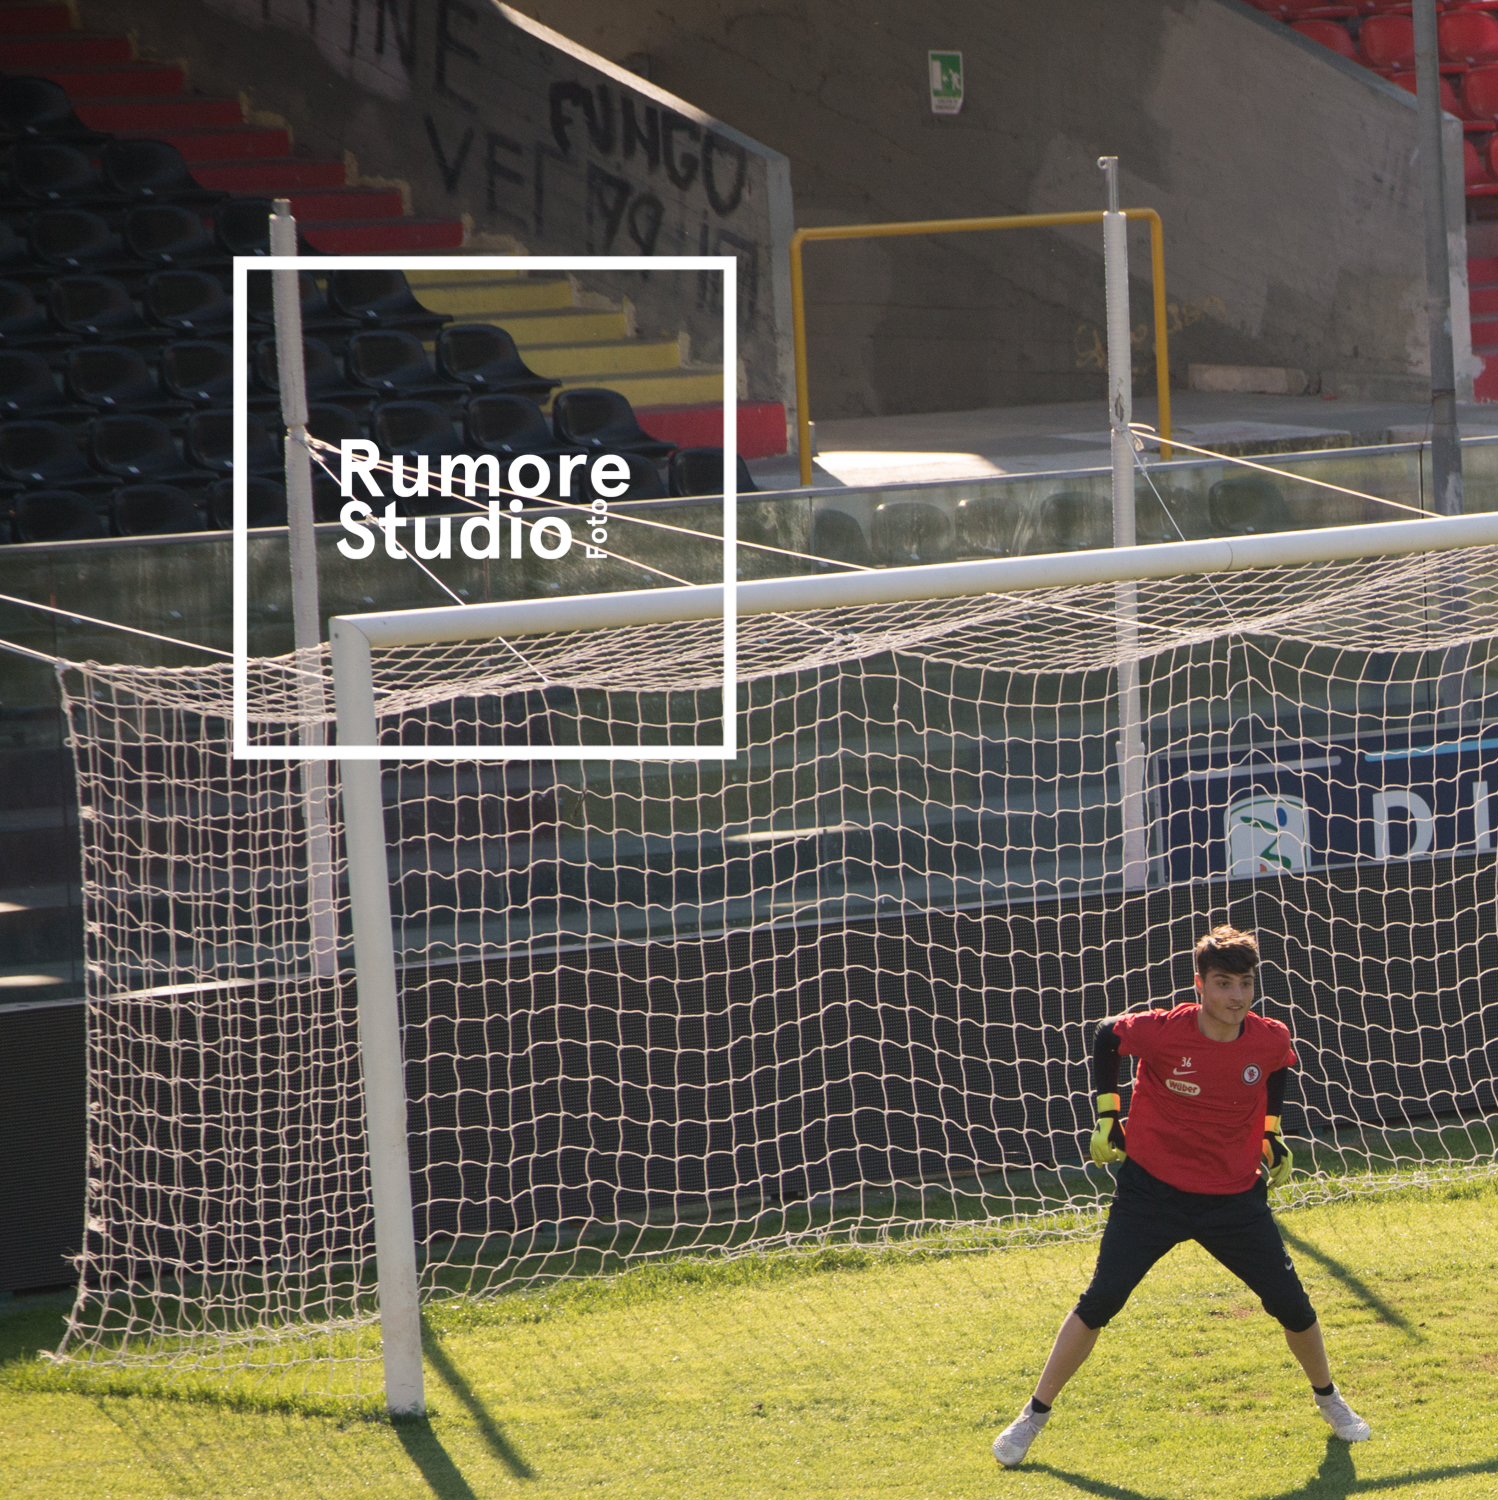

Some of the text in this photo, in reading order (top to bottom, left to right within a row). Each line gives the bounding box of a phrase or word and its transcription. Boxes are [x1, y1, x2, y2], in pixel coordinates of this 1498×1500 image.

[550, 80, 747, 217] FUNGO
[1180, 1056, 1193, 1068] 36
[1168, 1080, 1198, 1094] Wüber
